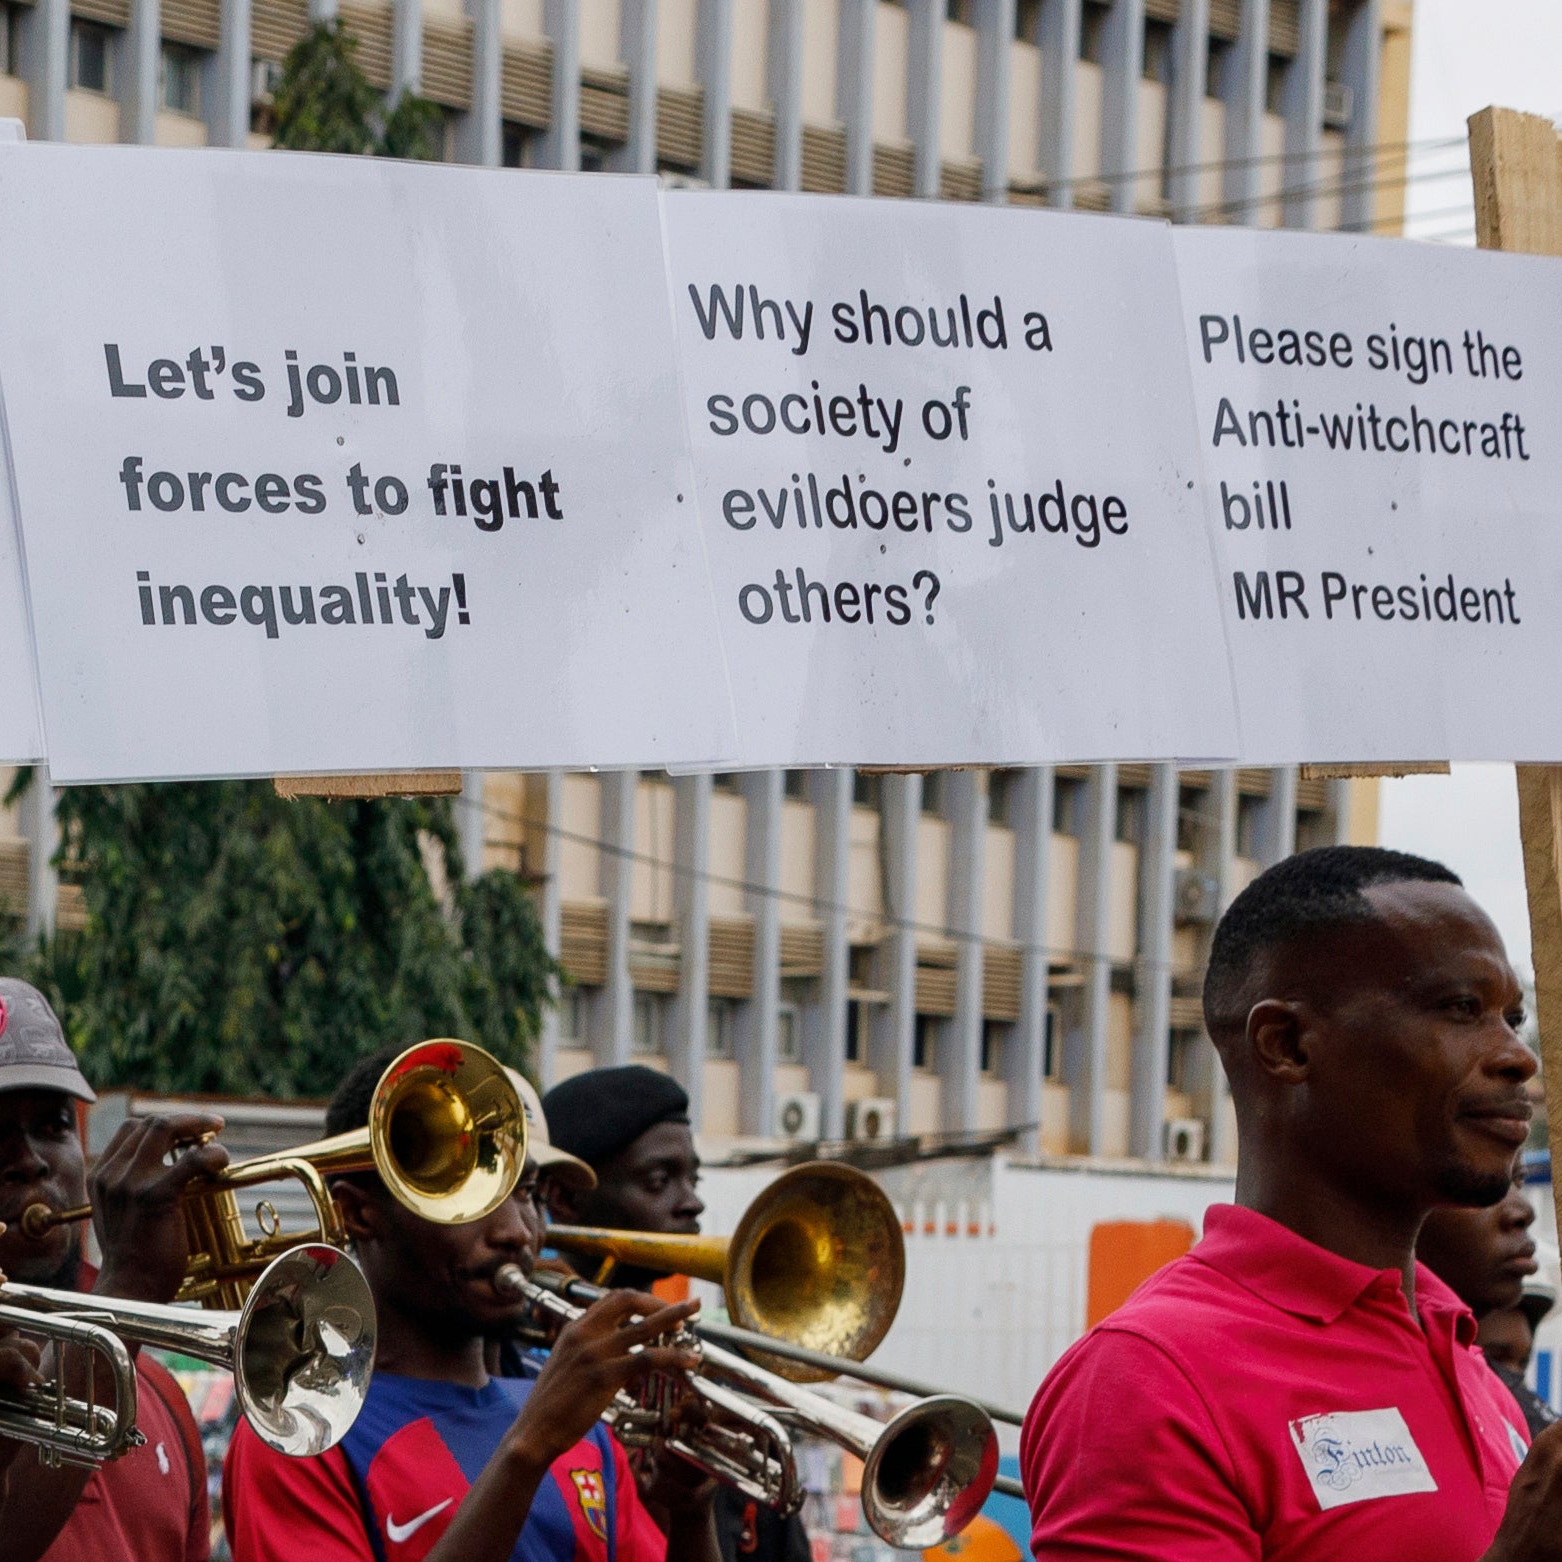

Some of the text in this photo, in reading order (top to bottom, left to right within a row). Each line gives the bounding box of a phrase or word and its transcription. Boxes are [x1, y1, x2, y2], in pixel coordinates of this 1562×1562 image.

[687, 283, 1053, 356] Why should a
[1199, 314, 1523, 385] Please sign the
[103, 343, 401, 418] Let's join
[707, 379, 972, 454] society of
[1212, 397, 1530, 461] Anti-witchcraft
[118, 456, 564, 533] forces to fight
[722, 472, 1129, 548] evildoers judge
[1220, 480, 1292, 530] bill
[136, 570, 471, 640] inequality!
[738, 567, 941, 626] others?
[1233, 570, 1521, 625] MR President
